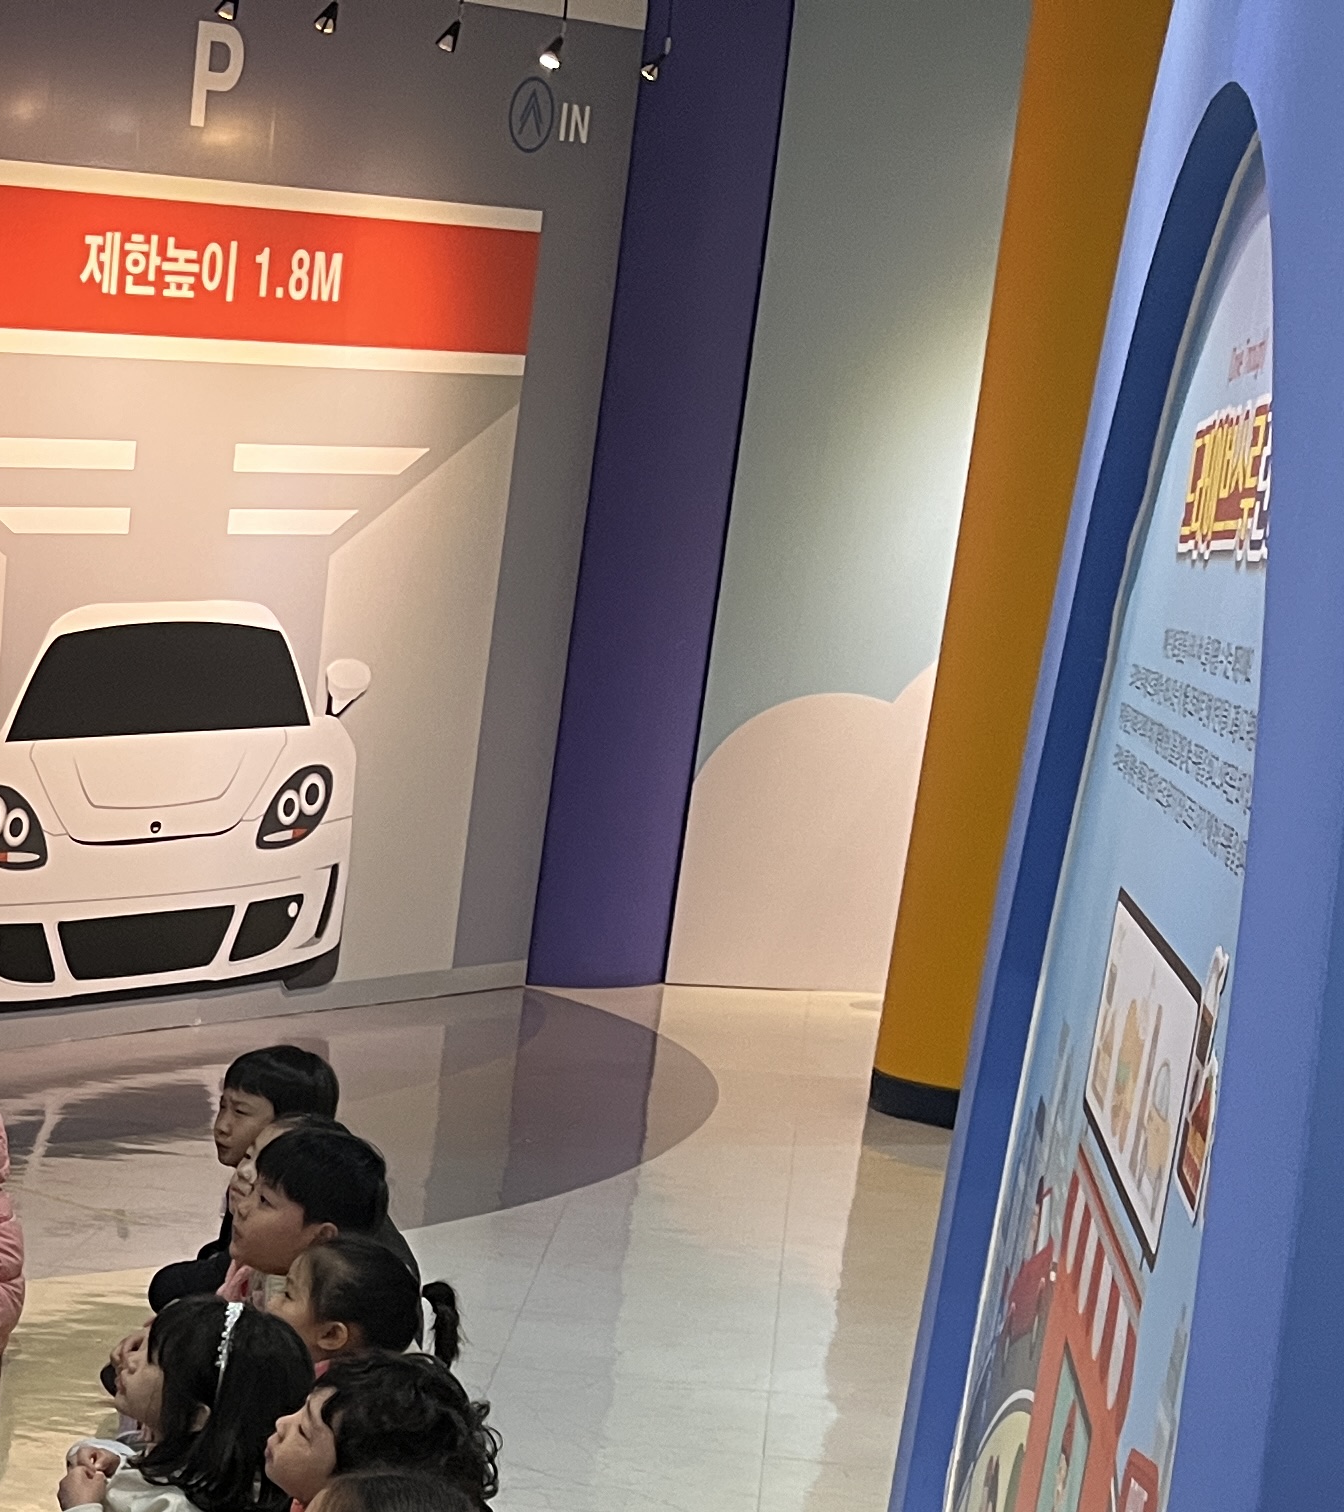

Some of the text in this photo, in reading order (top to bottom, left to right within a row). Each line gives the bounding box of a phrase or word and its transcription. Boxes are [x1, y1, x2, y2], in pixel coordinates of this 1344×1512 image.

[189, 20, 245, 127] P
[558, 101, 591, 145] IN
[79, 231, 344, 303] 제한높이 1.8M
